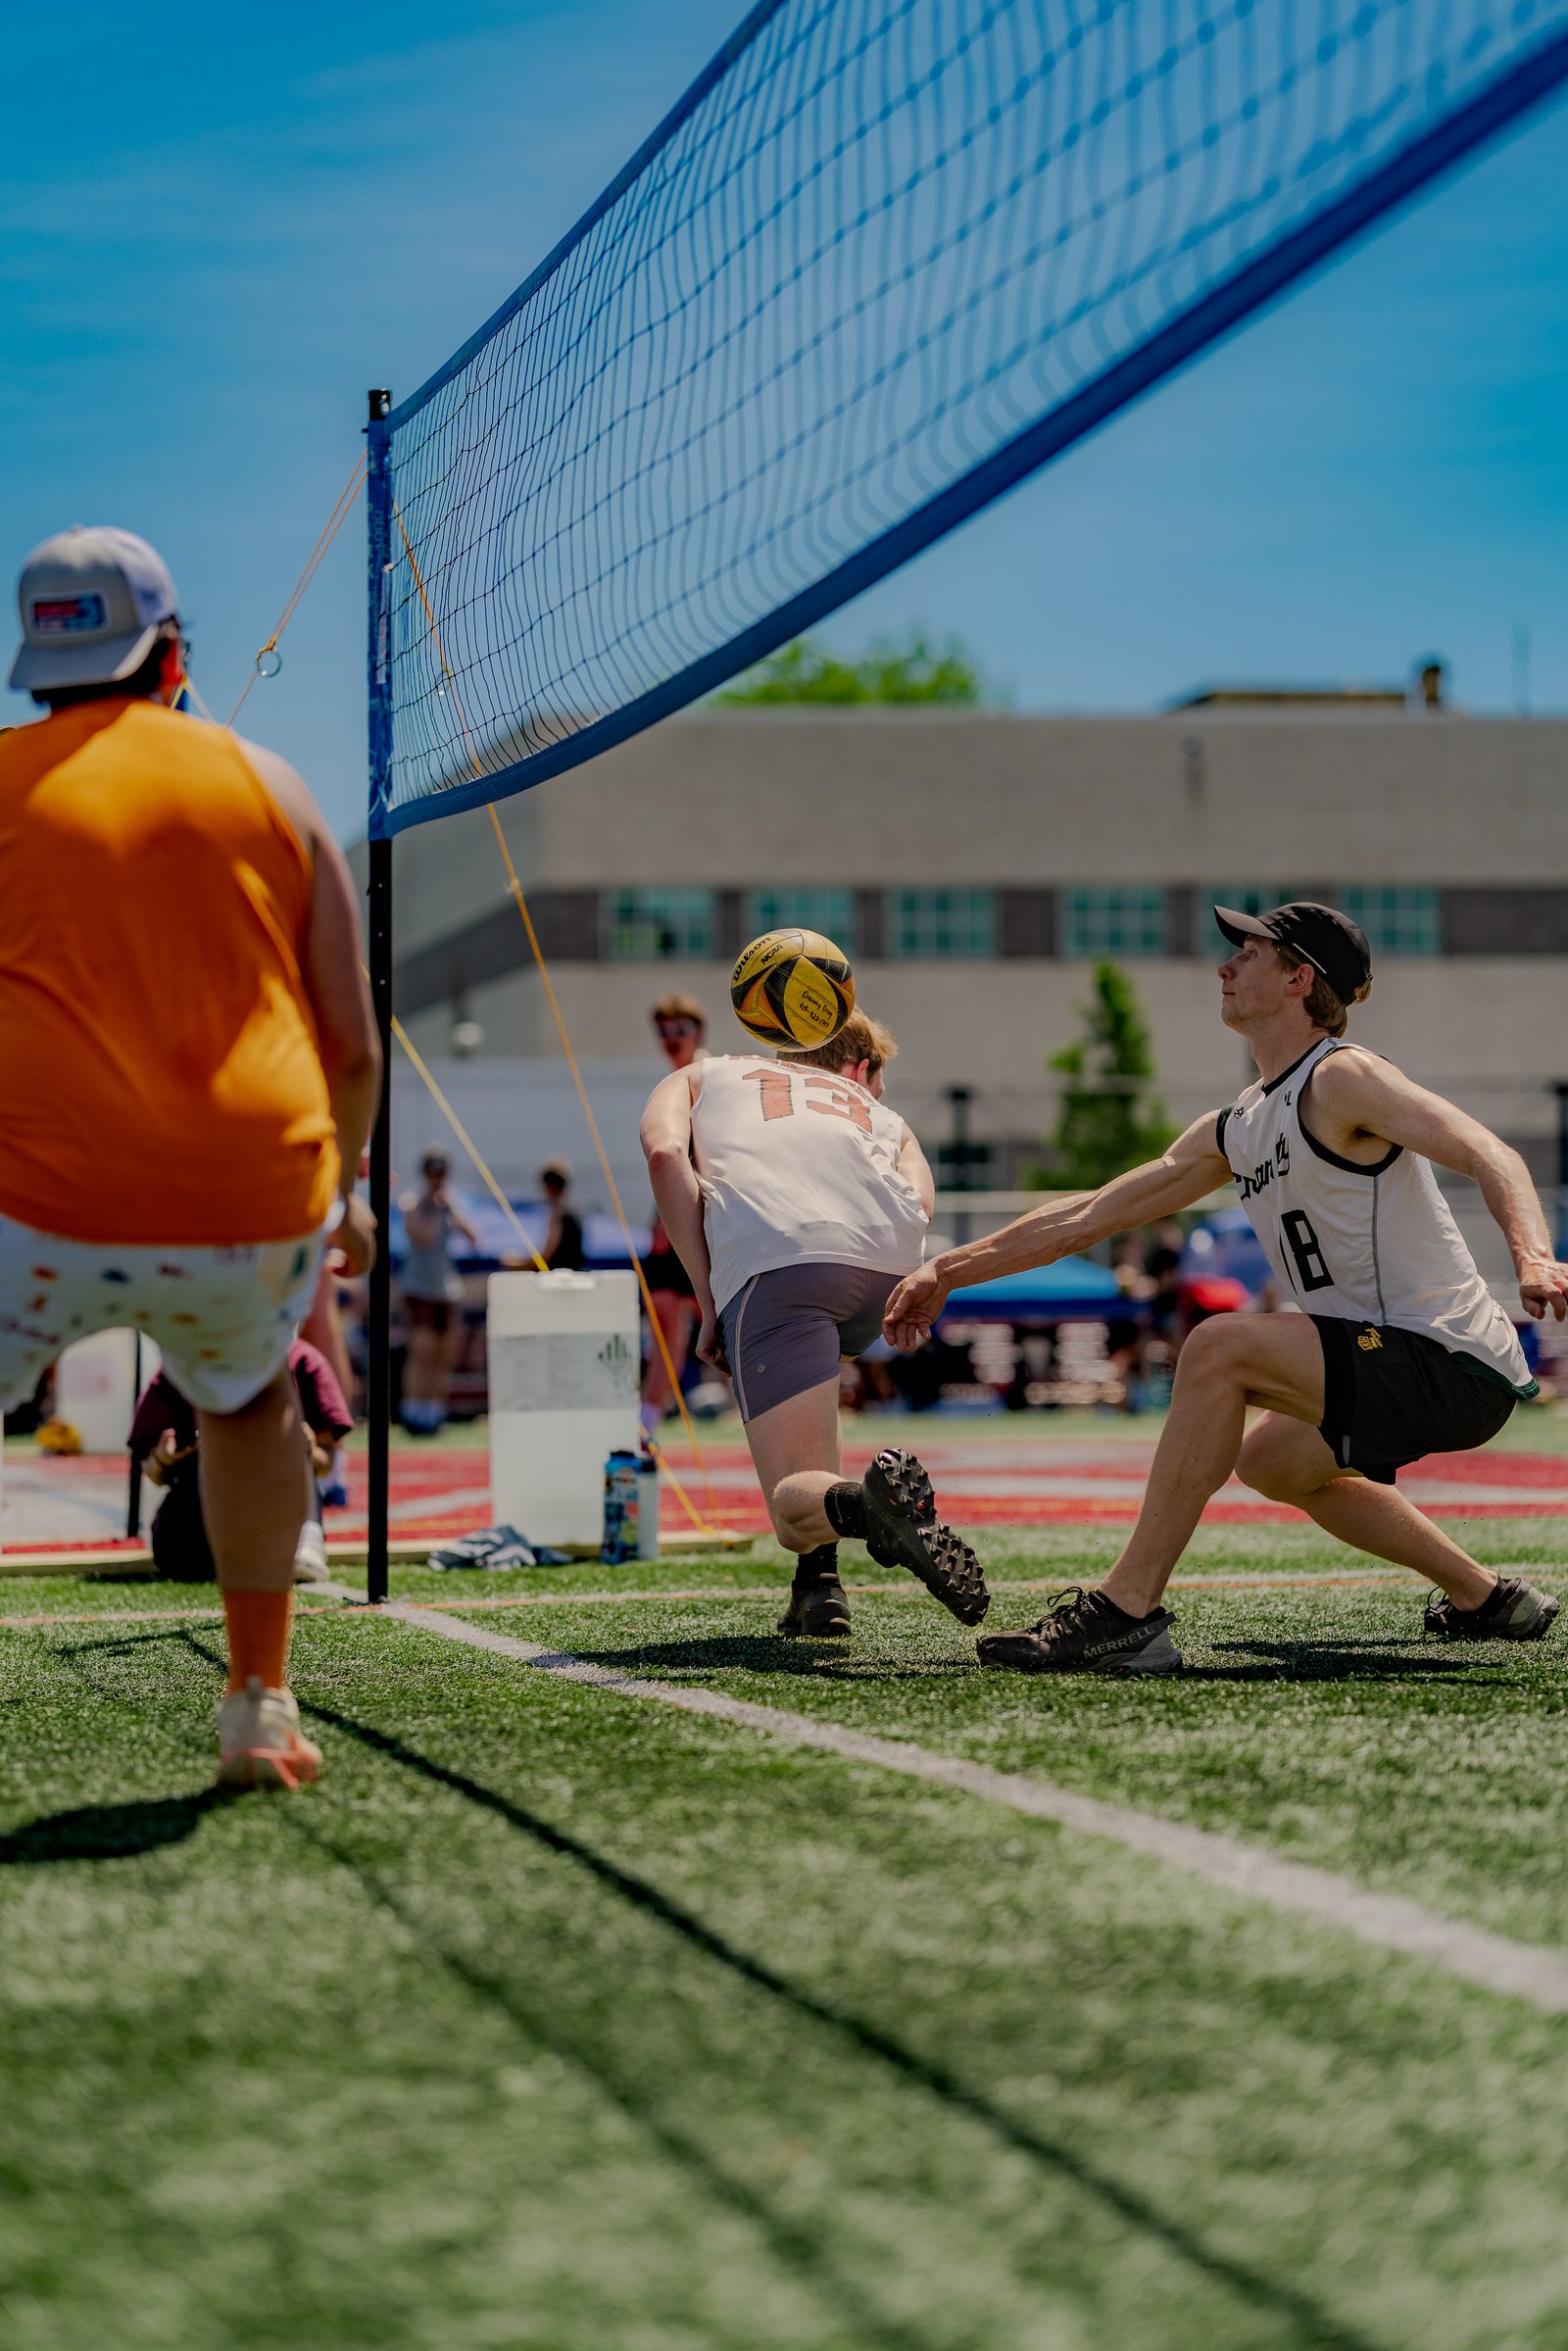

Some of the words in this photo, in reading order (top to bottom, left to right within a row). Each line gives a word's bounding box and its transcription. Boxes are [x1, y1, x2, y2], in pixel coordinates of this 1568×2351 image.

[734, 937, 772, 981] Wilson
[760, 944, 783, 965] NCAA
[742, 1068, 873, 1135] 13
[1280, 1208, 1335, 1297] 8
[1083, 1627, 1154, 1659] MERRELL
